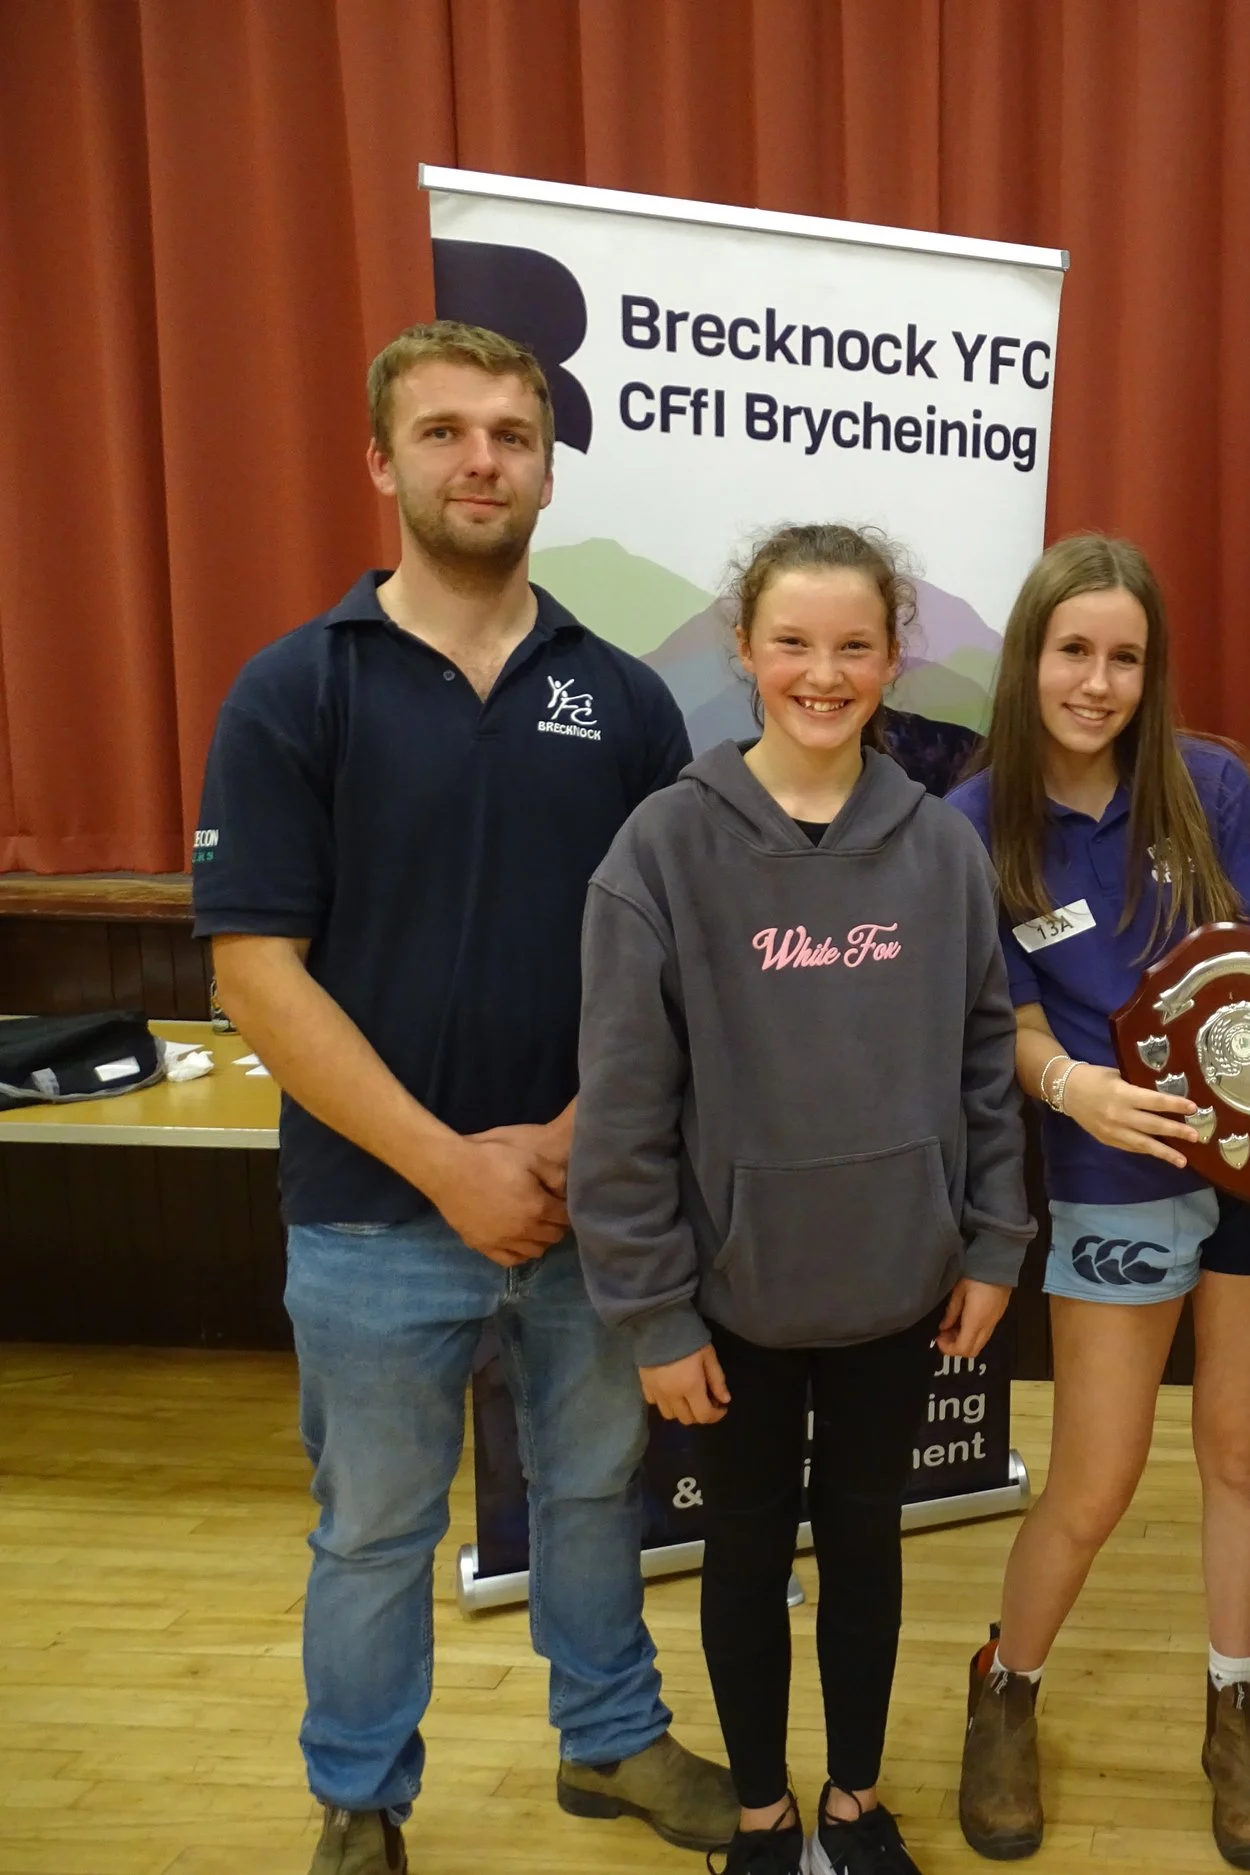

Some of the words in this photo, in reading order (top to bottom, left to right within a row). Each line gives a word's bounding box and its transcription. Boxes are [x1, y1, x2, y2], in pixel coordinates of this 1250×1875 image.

[621, 294, 939, 379] Brecknock
[951, 330, 1051, 390] YFC
[745, 392, 1038, 473] Brycheiniog
[537, 720, 602, 741] BRECKNOCK
[752, 925, 841, 971] White
[843, 922, 902, 968] Fox
[1036, 914, 1074, 941] 13A
